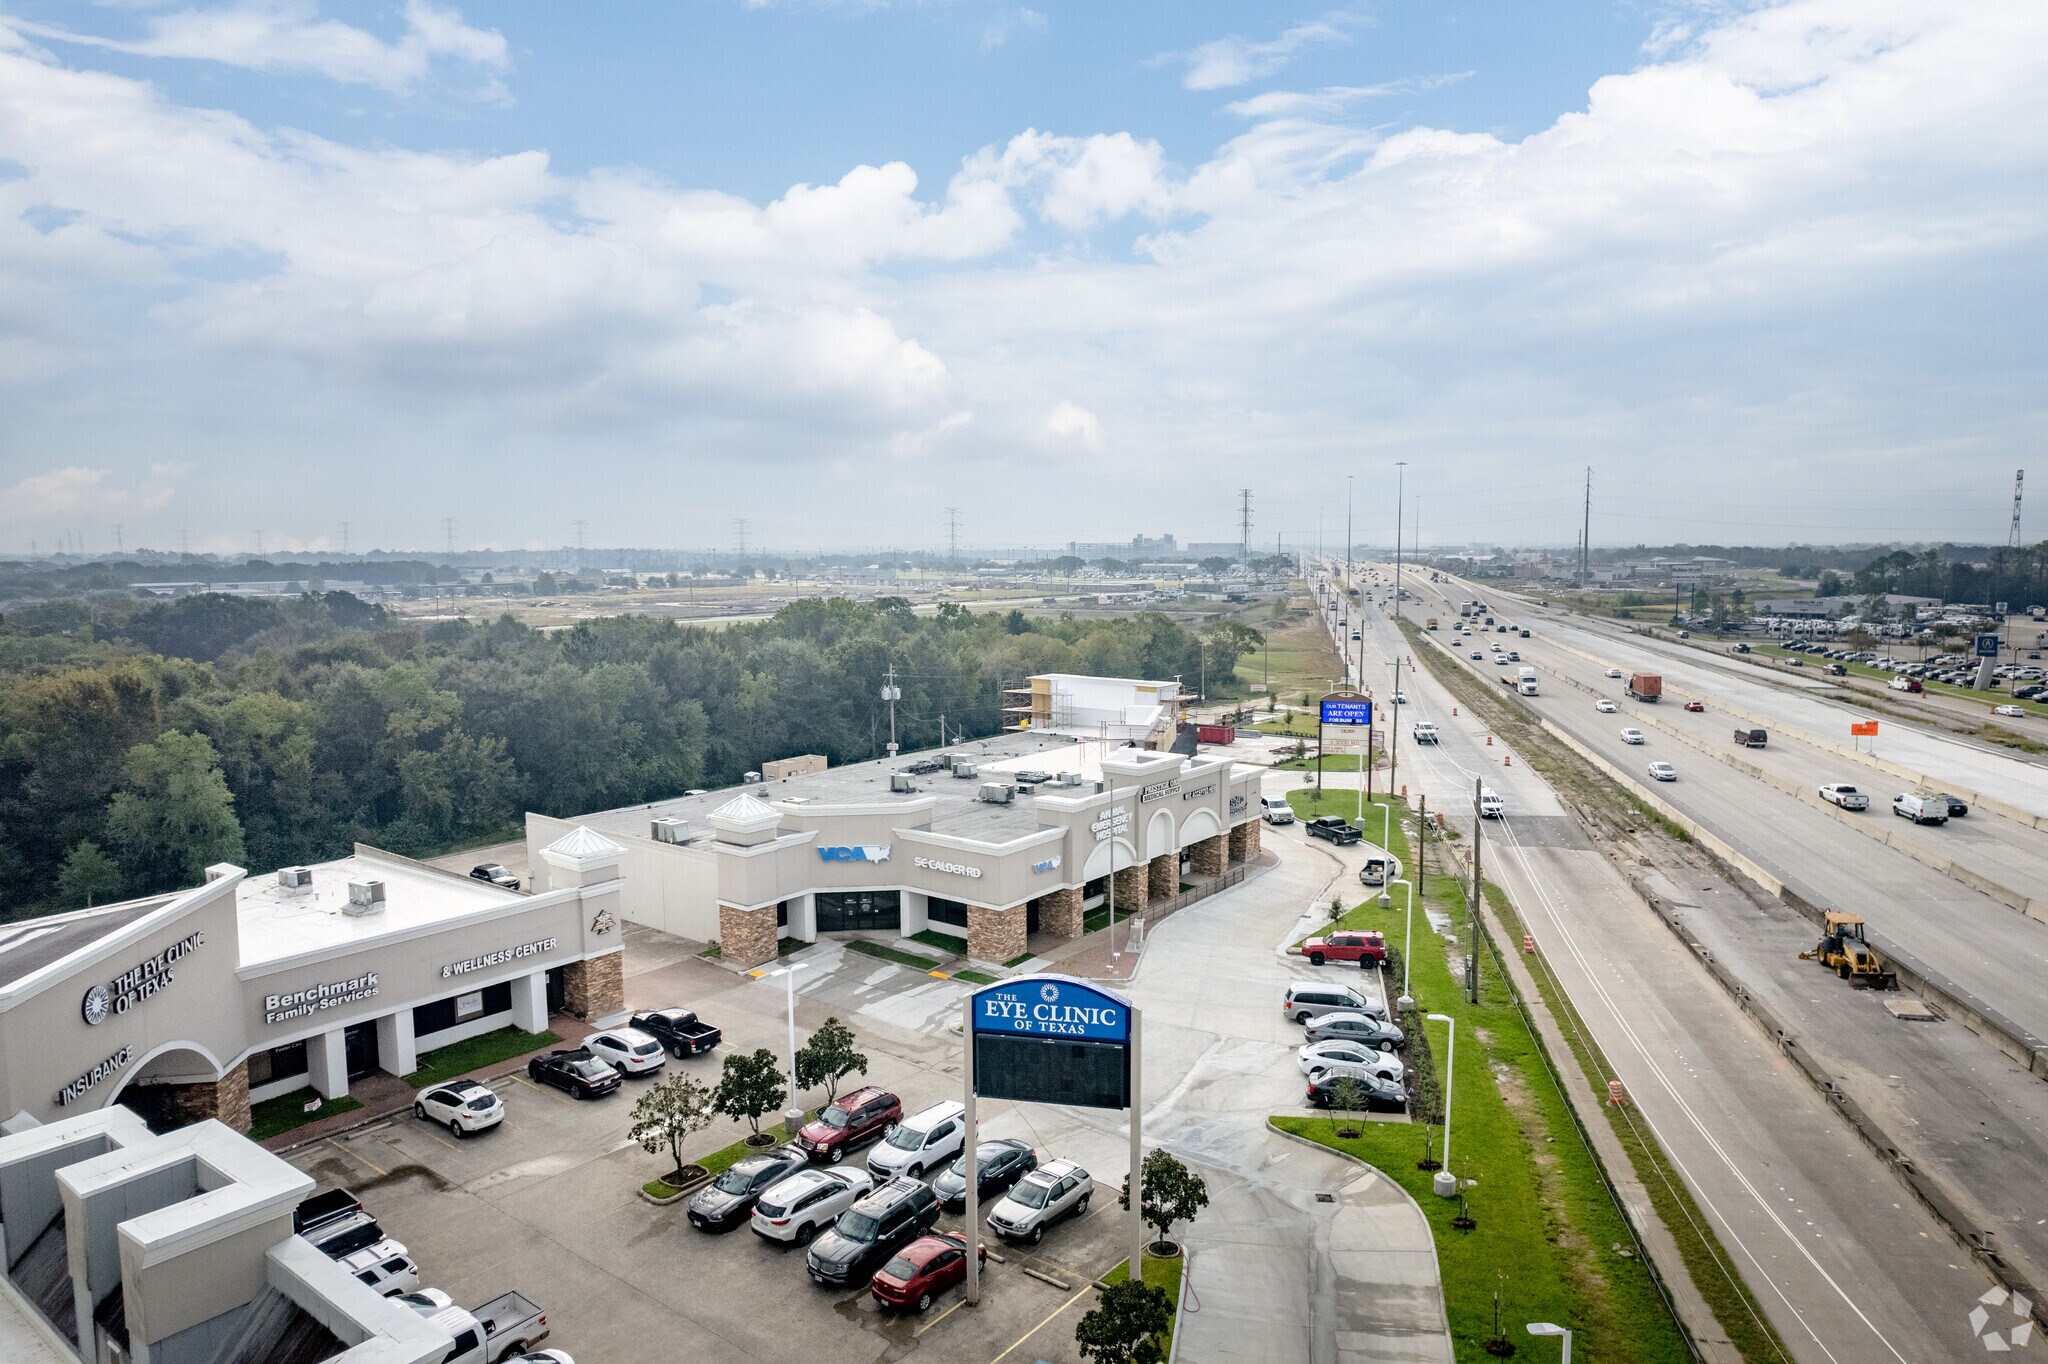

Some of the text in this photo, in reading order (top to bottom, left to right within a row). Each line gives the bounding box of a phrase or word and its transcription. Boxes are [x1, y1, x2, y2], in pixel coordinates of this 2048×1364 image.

[1100, 805, 1126, 820] ANMAL
[816, 845, 868, 863] VCA
[914, 856, 982, 878] SE CALDER RD
[1032, 859, 1053, 874] VCA
[114, 931, 204, 995] THE EYE CLINIC
[442, 938, 558, 978] & WELLNESS CENTER
[116, 968, 174, 1014] OF TEXAS
[266, 972, 378, 1011] Benchmark
[996, 994, 1018, 1002] THE
[266, 987, 380, 1024] Family Services
[986, 1000, 1116, 1026] EYE CLINIC
[1014, 1020, 1085, 1034] OF TEXAS
[62, 1045, 135, 1106] INSURANCE
